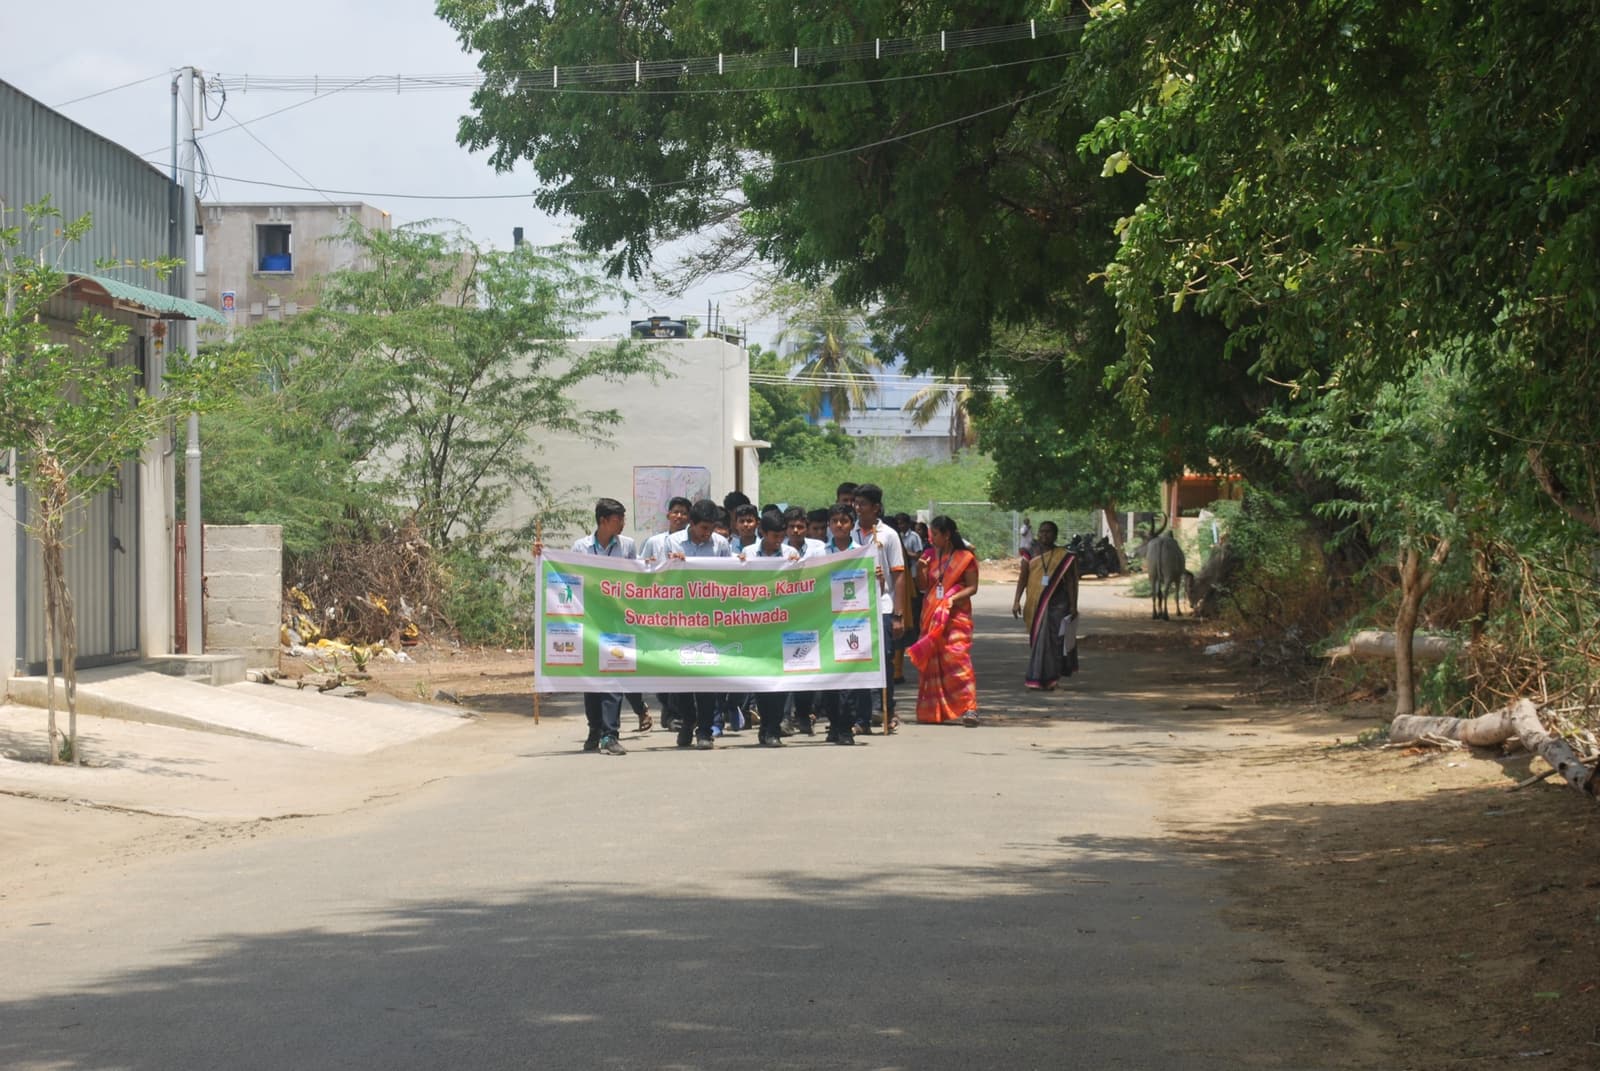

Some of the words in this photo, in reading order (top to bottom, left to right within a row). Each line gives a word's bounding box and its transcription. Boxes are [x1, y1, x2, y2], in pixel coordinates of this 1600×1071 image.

[600, 580, 621, 597] Sri
[624, 582, 684, 600] Sankara
[688, 580, 771, 601] Vidhyalaya,
[775, 579, 815, 595] Karur
[625, 609, 709, 627] Swatchhata
[713, 607, 788, 626] Pakhwada
